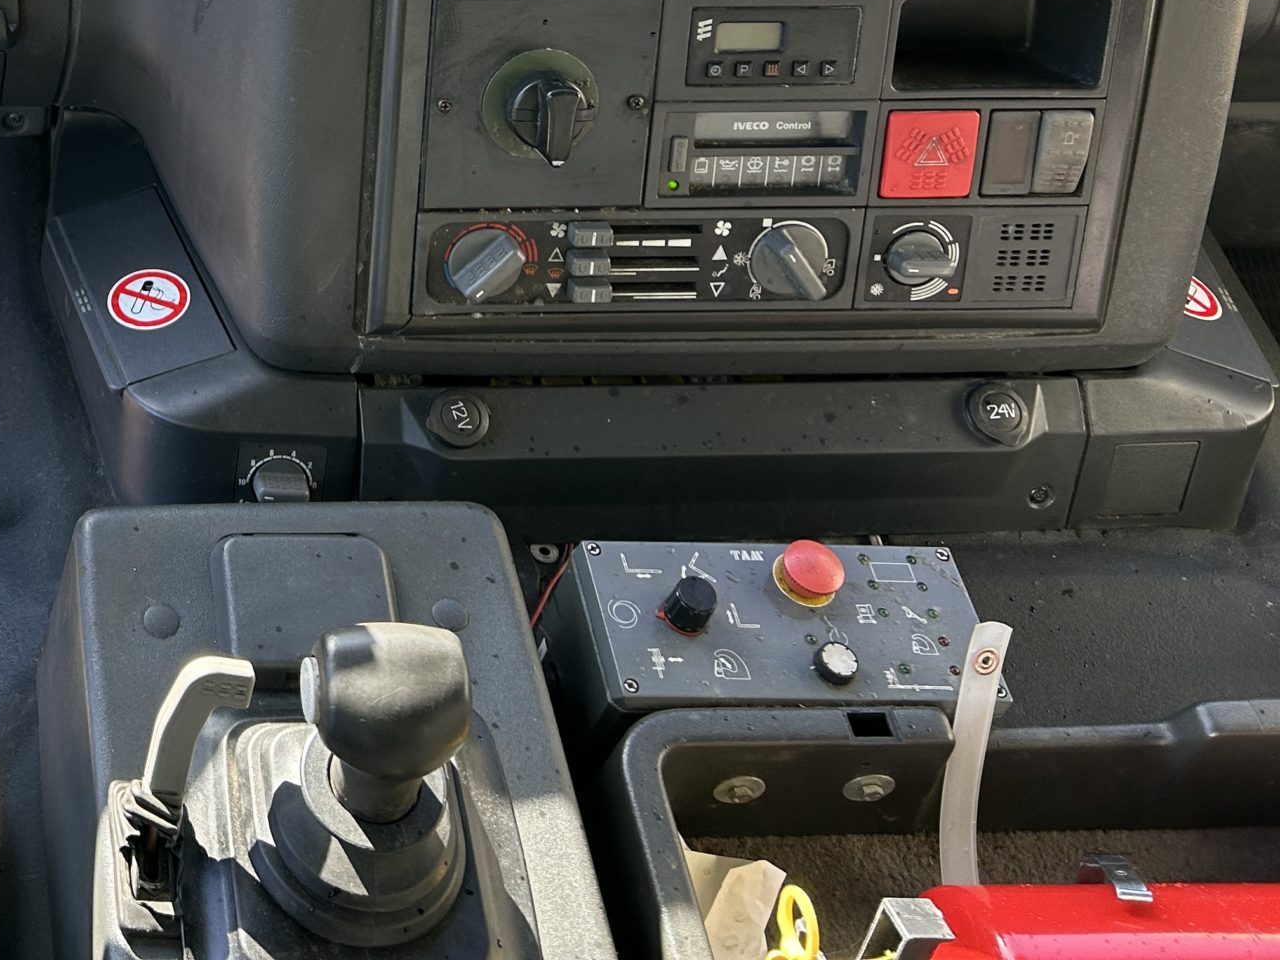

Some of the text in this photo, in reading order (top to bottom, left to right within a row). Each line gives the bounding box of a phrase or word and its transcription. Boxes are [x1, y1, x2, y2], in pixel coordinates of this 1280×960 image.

[740, 64, 749, 75] P
[733, 120, 812, 130] IVECO Control
[450, 400, 473, 429] 12V
[986, 402, 1016, 419] 24V
[307, 461, 313, 469] 2
[238, 478, 246, 486] 10
